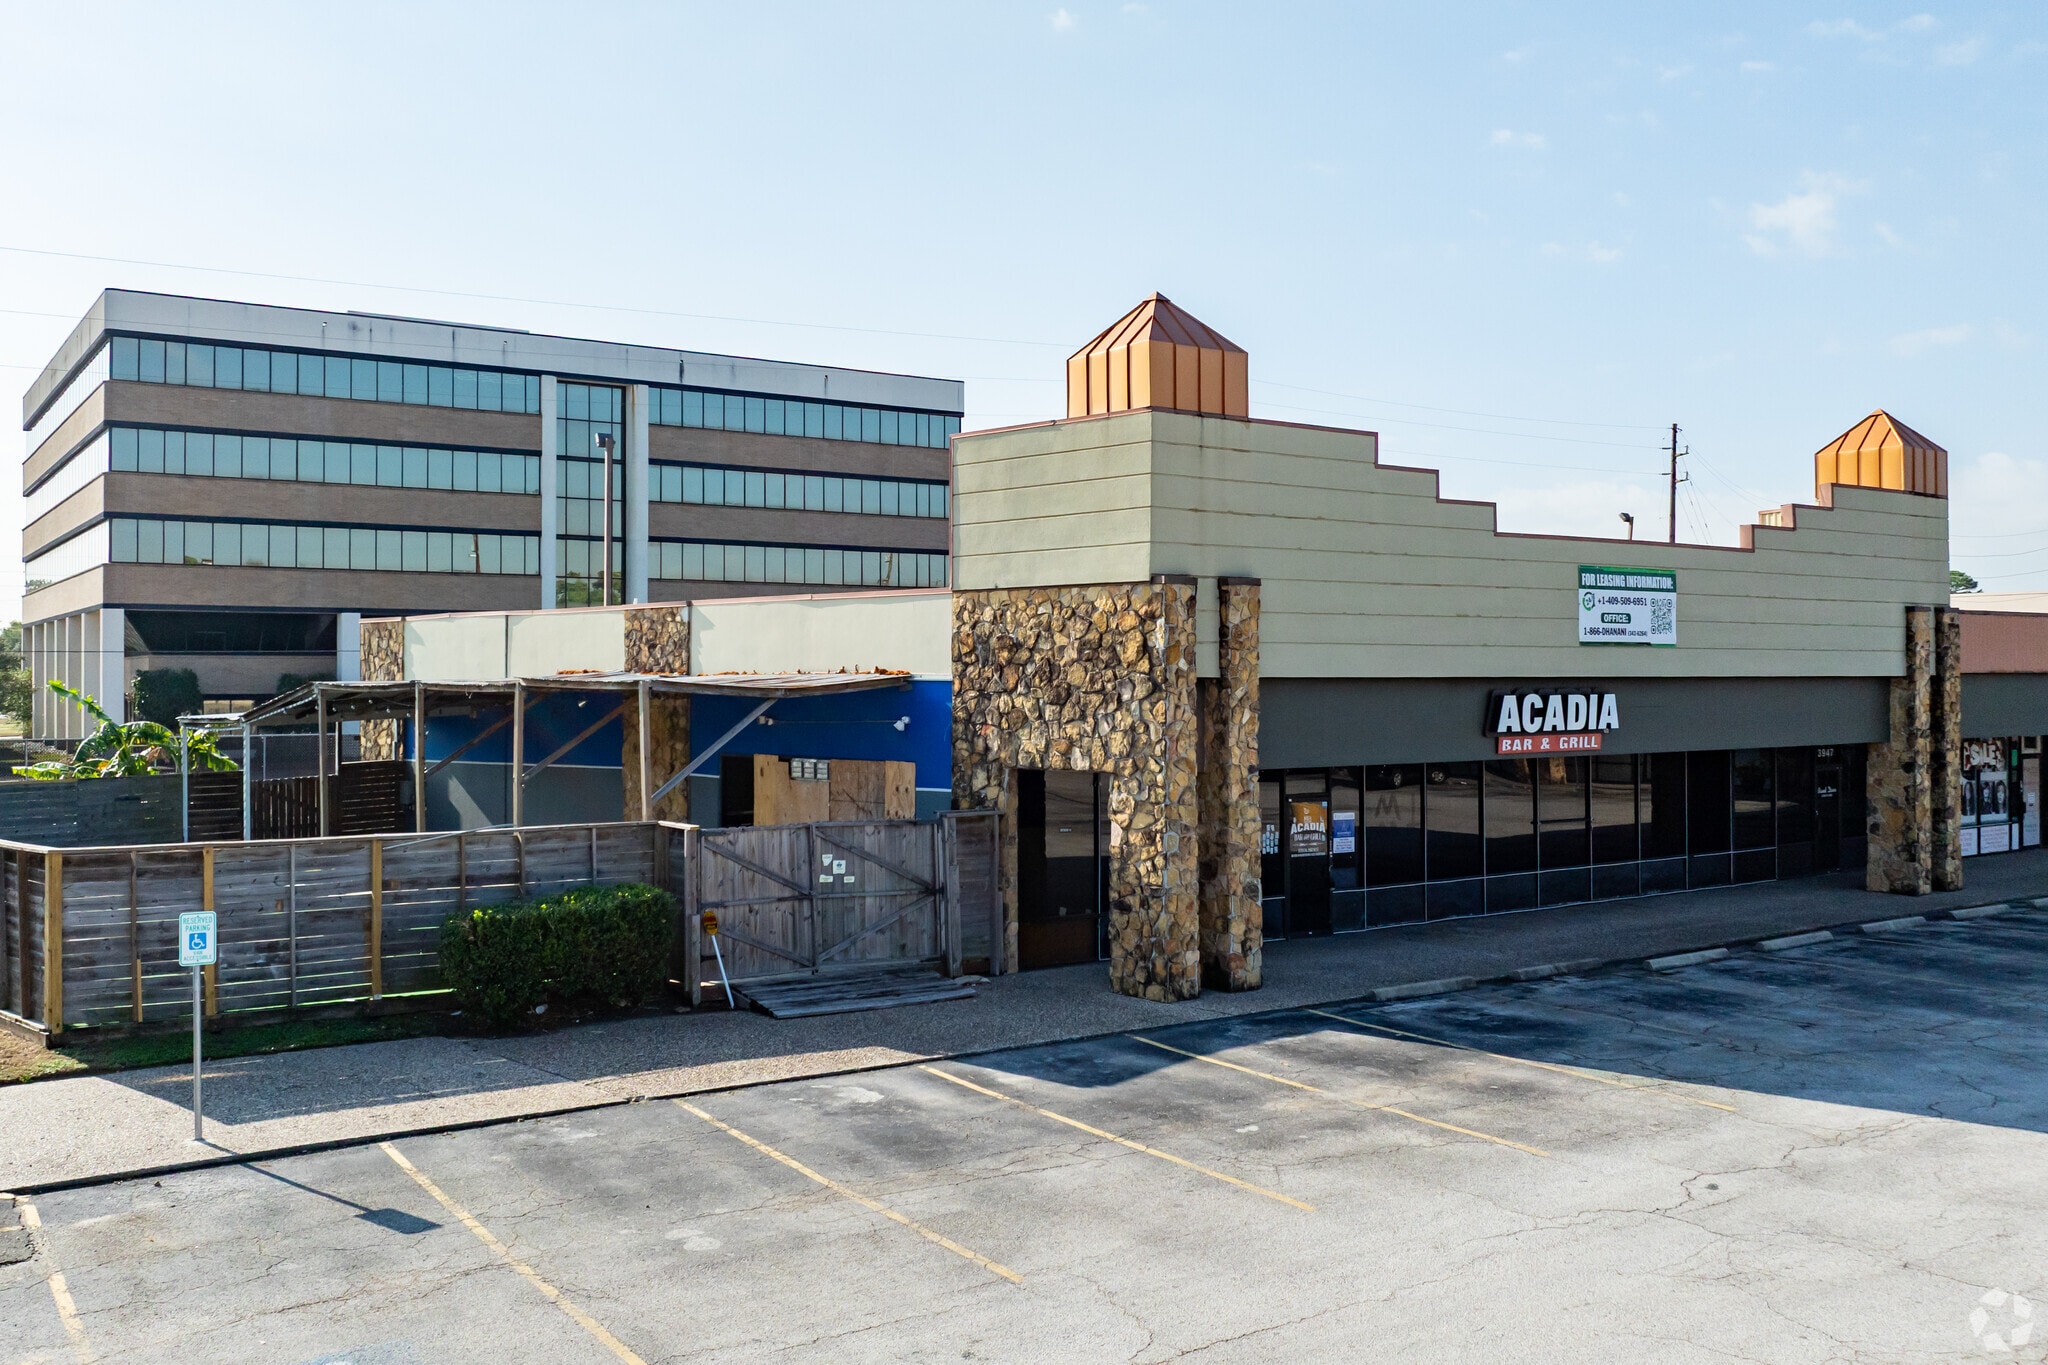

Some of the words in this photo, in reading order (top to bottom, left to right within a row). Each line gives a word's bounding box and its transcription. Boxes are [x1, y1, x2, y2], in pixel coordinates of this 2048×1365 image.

[1581, 573, 1596, 586] FOR
[1596, 574, 1626, 587] LEASING
[1626, 575, 1674, 589] INFORMATION:
[1597, 596, 1648, 606] +1-409-509-6951
[1603, 614, 1629, 623] OFFICE:
[1583, 627, 1627, 636] 1-866-DHANANI
[1497, 693, 1620, 733] ACADIA
[1502, 738, 1532, 751] BAR
[1540, 737, 1550, 750] &
[1559, 736, 1598, 749] GRILL
[1290, 822, 1326, 834] ACADIA
[183, 916, 213, 925] RESERVED
[185, 924, 211, 932] PARKING
